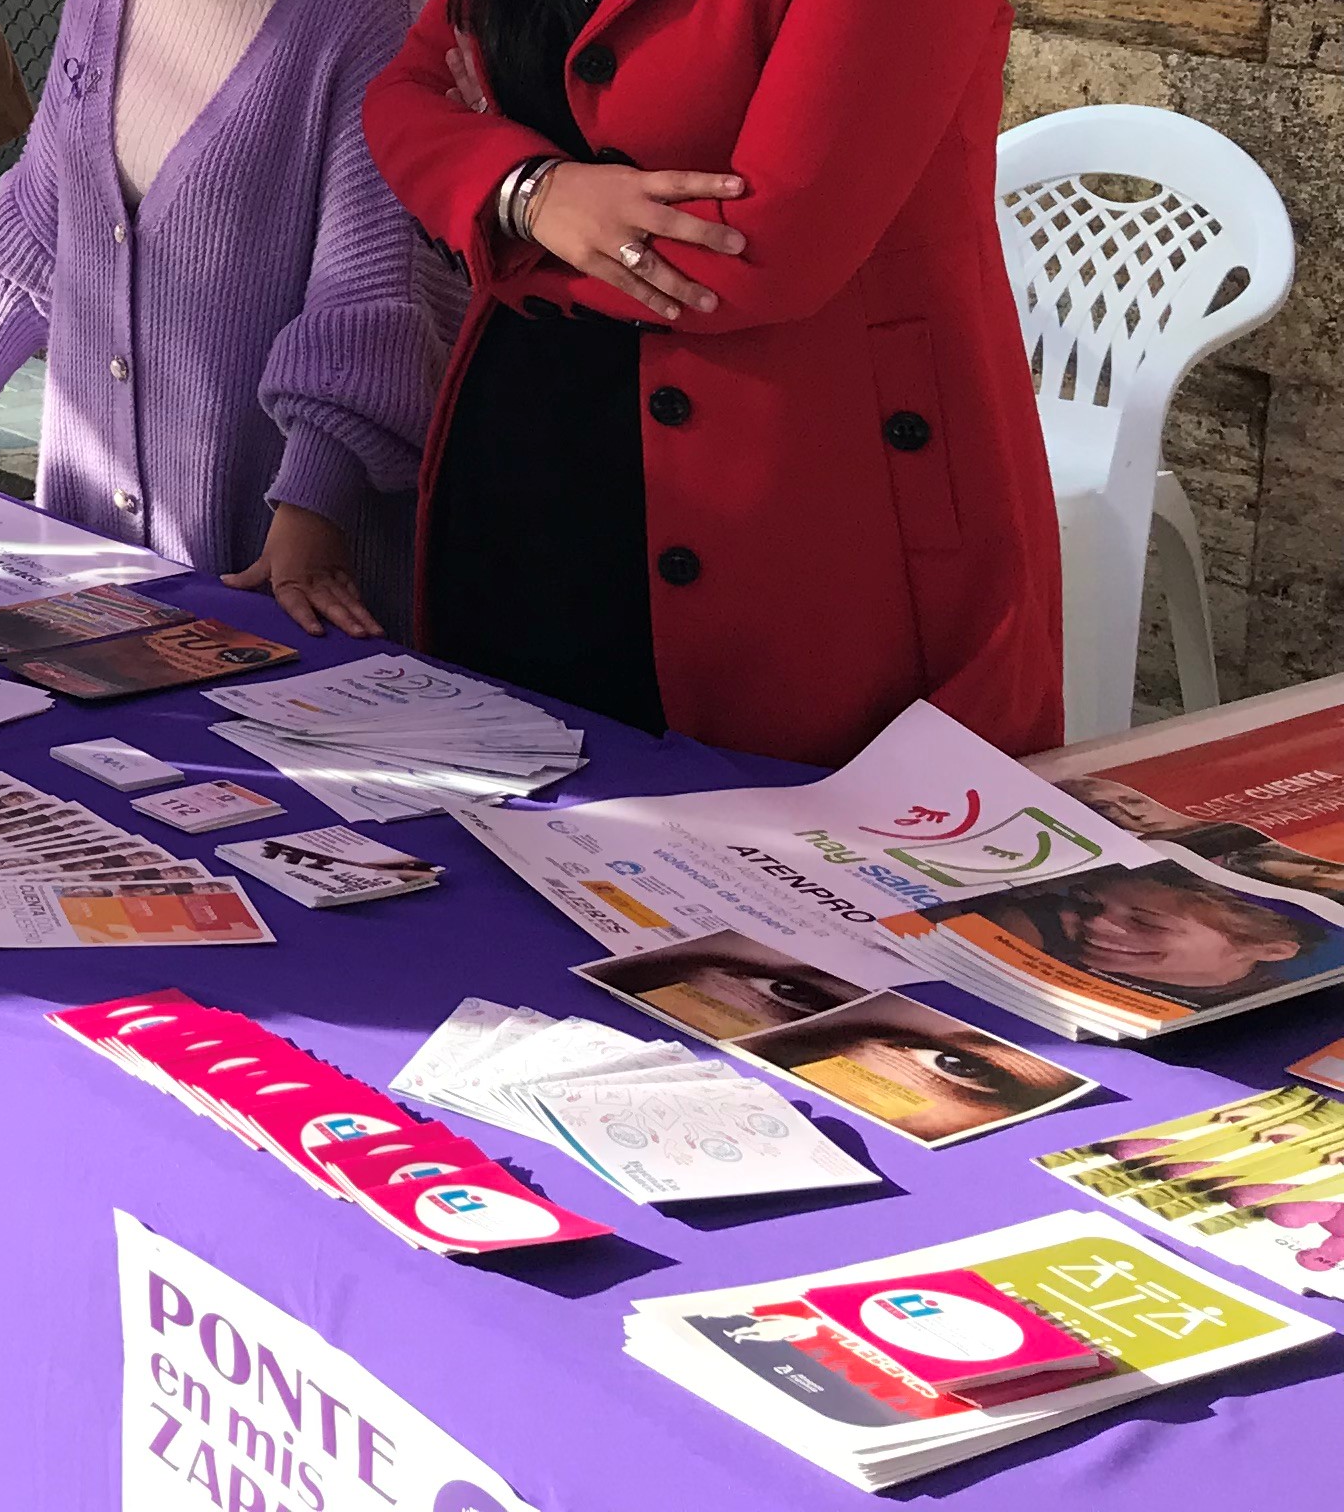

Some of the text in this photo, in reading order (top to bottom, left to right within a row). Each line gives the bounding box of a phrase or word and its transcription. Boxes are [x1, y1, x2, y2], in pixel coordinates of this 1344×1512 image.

[1244, 769, 1342, 800] CUENTA
[161, 798, 201, 816] 112
[793, 829, 869, 864] hay
[19, 884, 46, 917] CUENTA
[717, 889, 741, 903] de
[726, 844, 876, 923] ATENPRO
[148, 1269, 398, 1506] PONTE
[150, 1352, 326, 1512] en mis
[148, 1401, 293, 1512] ZAP
